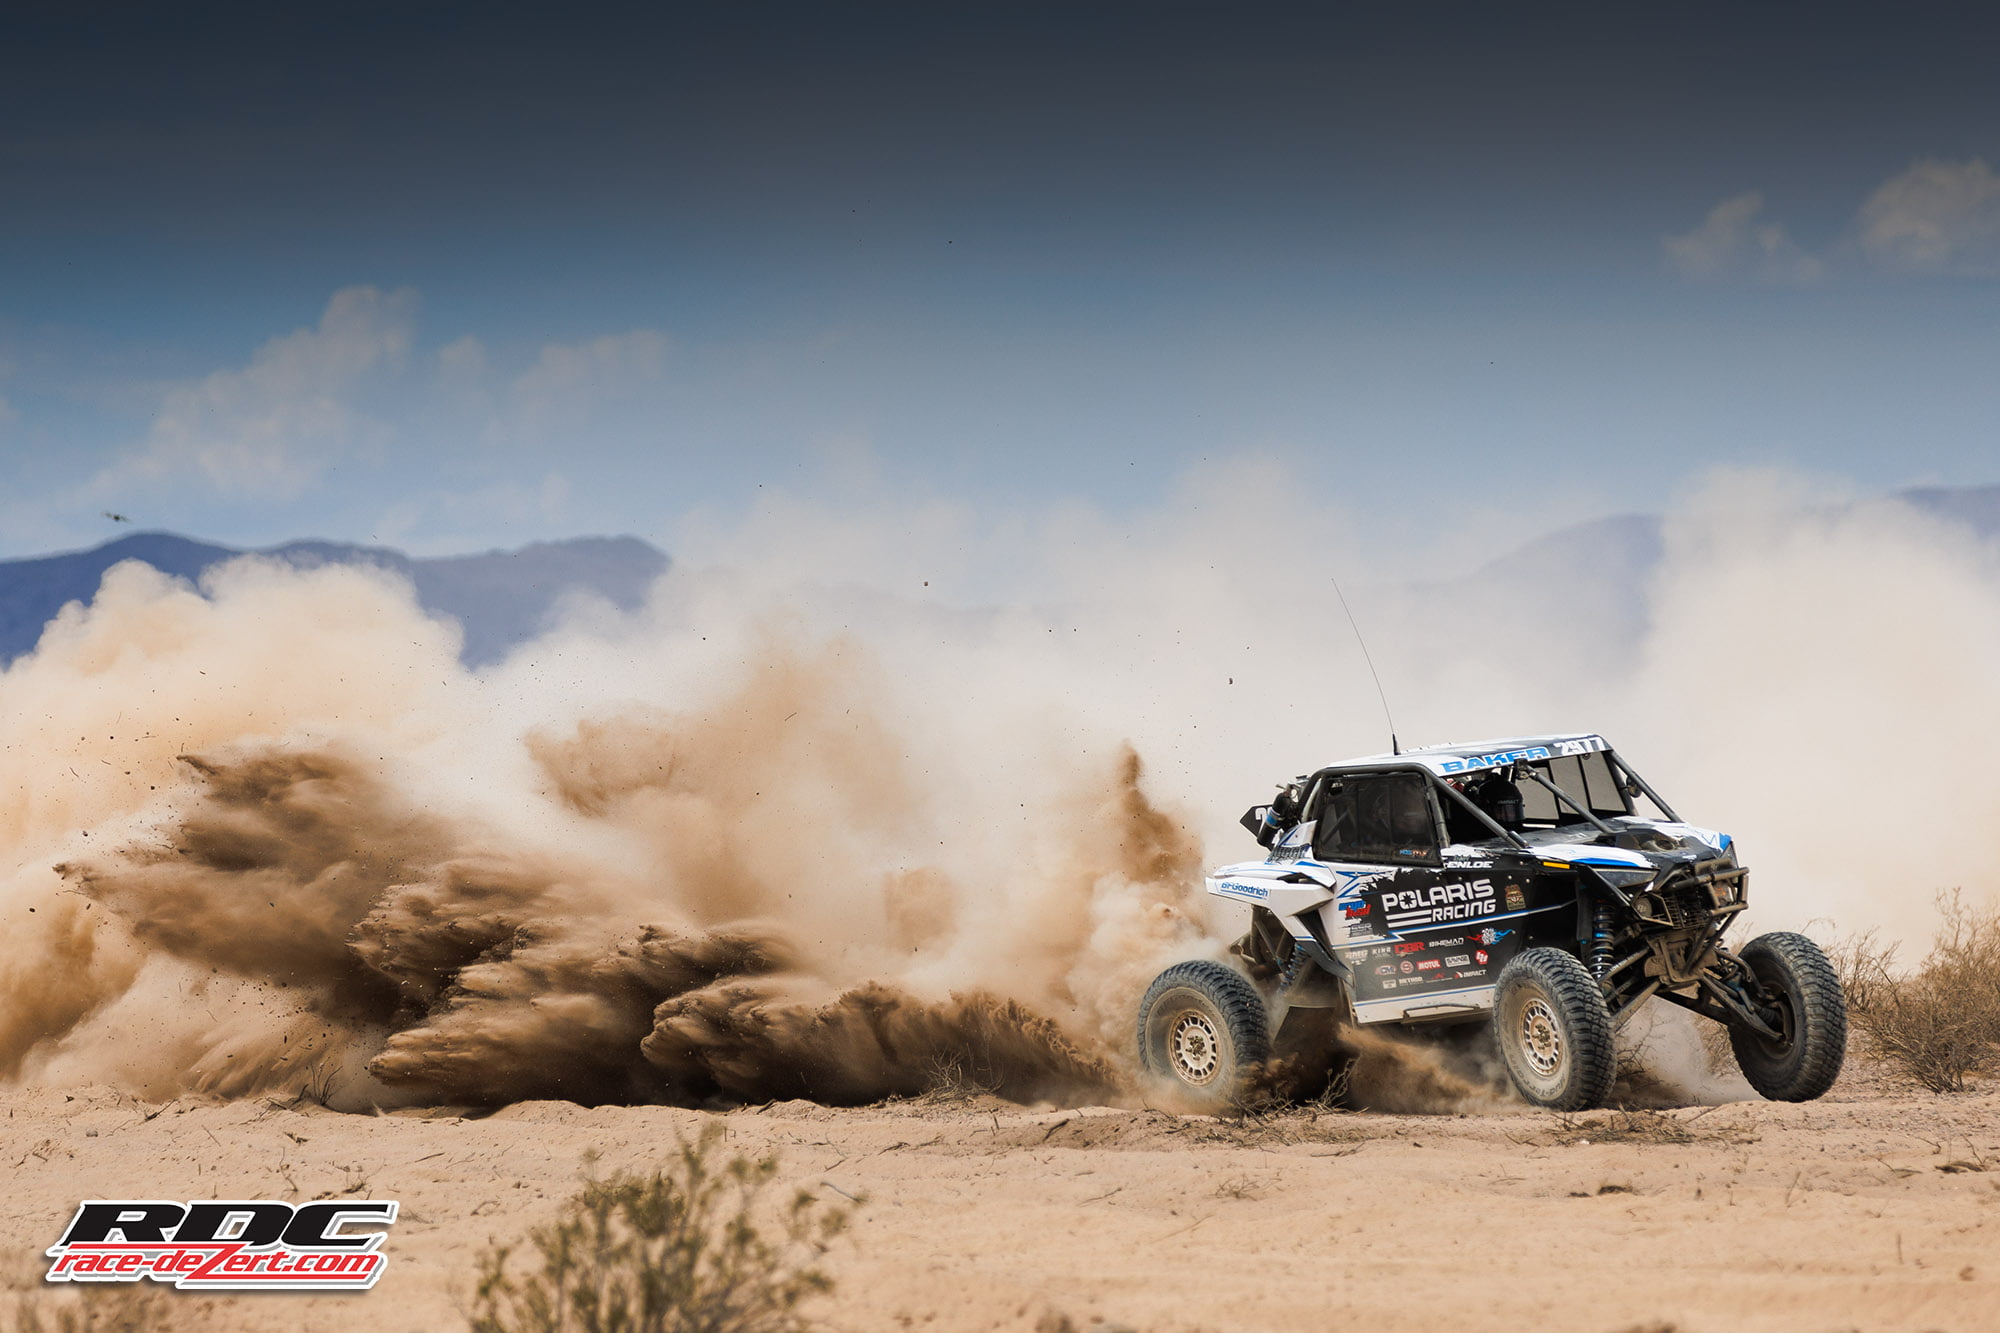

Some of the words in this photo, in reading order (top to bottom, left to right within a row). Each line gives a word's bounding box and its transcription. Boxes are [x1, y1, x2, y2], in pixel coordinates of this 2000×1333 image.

[1440, 747, 1549, 773] BAKER
[1220, 882, 1268, 897] BFGoodrich
[1381, 878, 1495, 912] POLARIS
[1432, 899, 1497, 923] RACING
[1417, 960, 1441, 970] MOTUL
[1463, 969, 1487, 978] IMPACT
